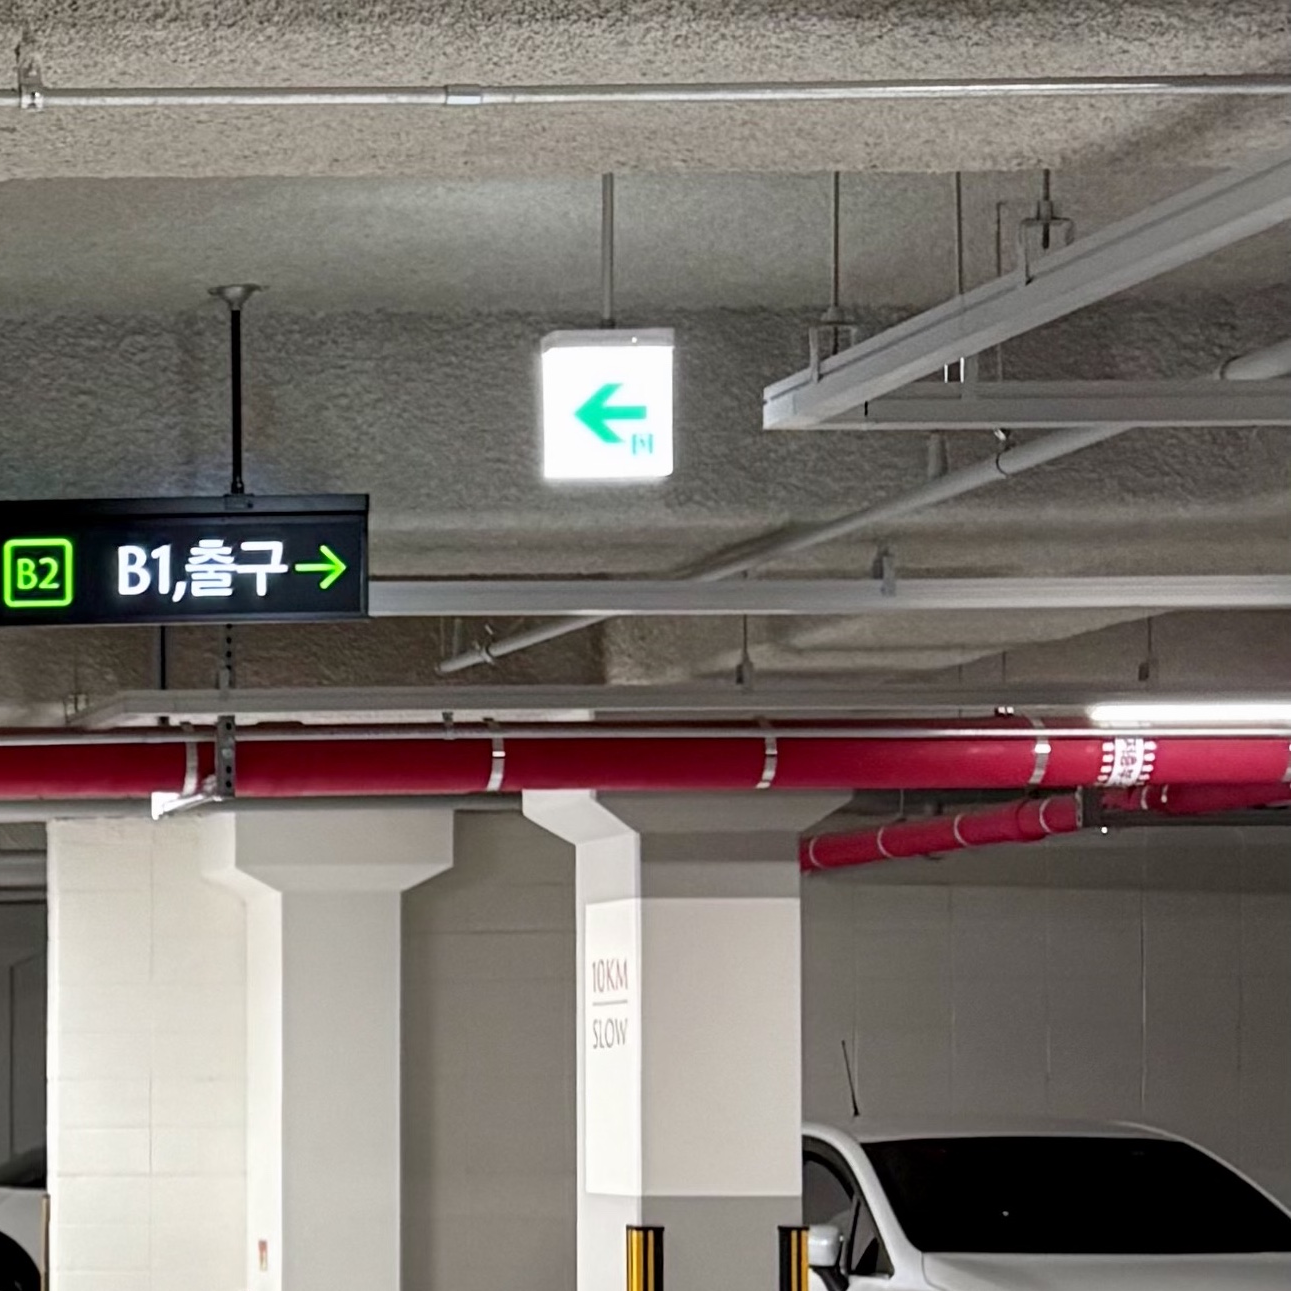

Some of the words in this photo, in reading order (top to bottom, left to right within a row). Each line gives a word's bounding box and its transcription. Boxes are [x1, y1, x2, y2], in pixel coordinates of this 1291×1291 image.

[17, 557, 60, 590] B2
[118, 539, 289, 603] B1,출구
[592, 958, 628, 993] 10KM
[593, 1018, 628, 1049] SLOW
